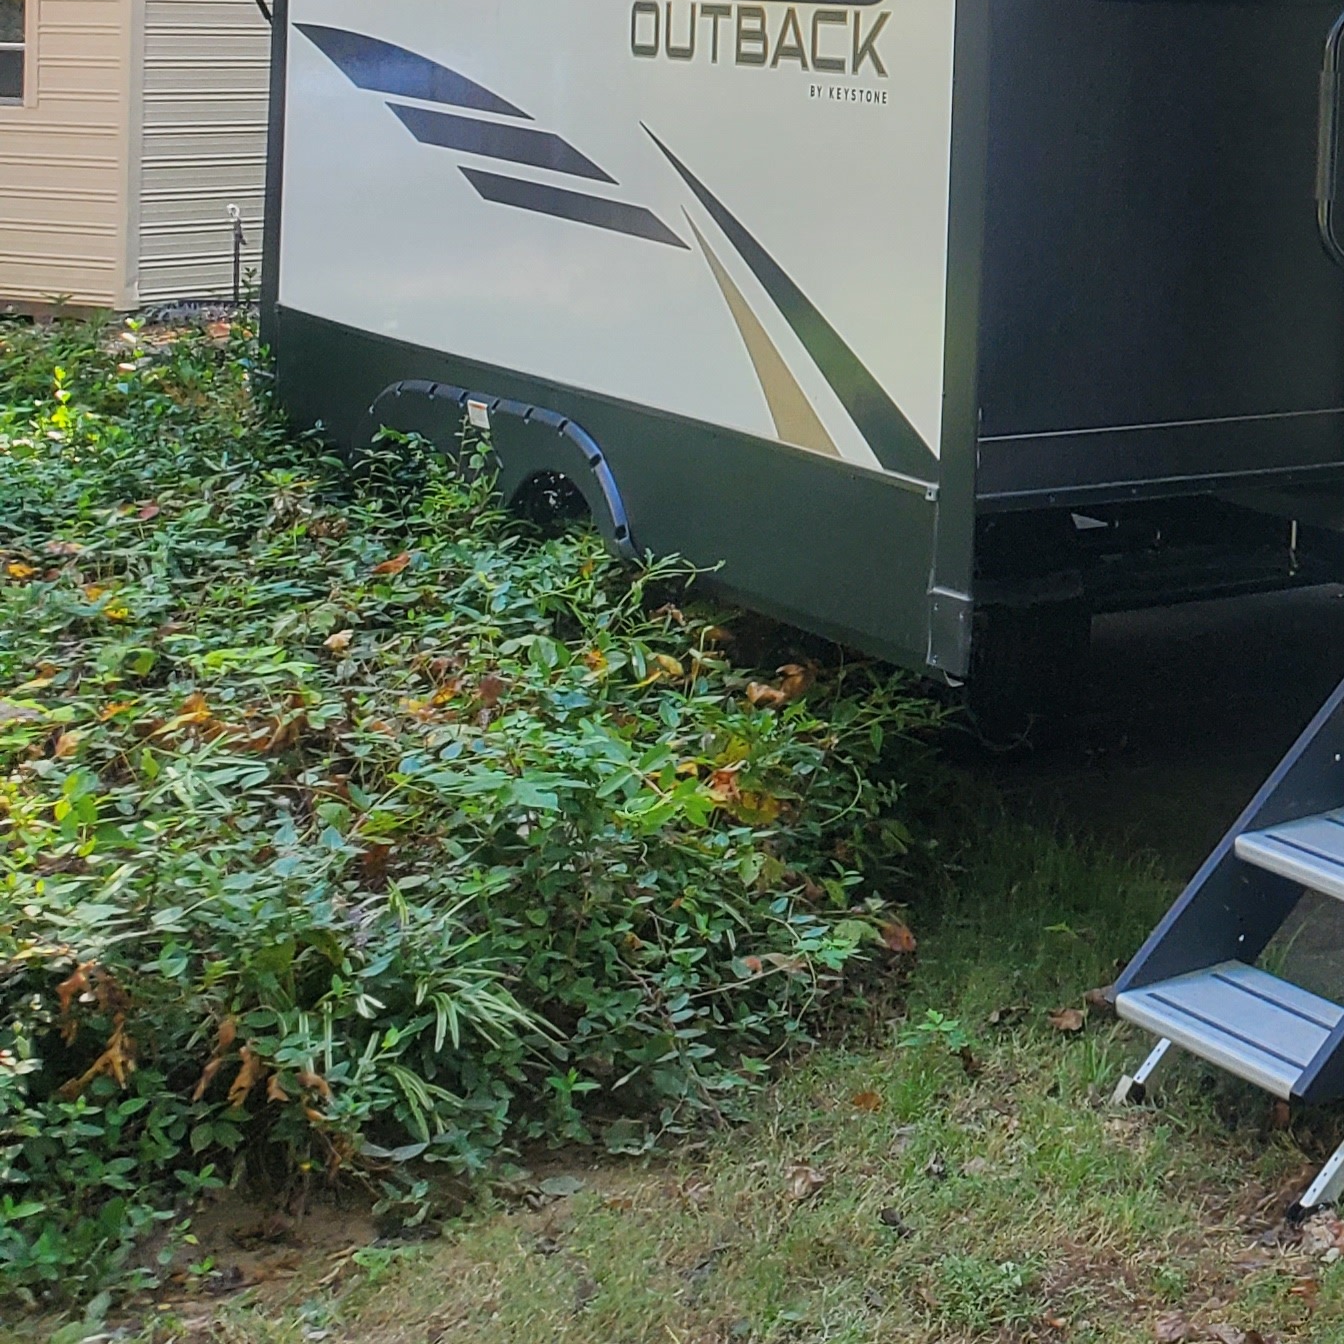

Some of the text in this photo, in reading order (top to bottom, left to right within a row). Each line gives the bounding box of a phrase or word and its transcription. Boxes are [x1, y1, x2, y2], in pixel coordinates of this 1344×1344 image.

[630, 0, 892, 78] OUTBACK
[809, 85, 888, 104] BY KEYSTONE
